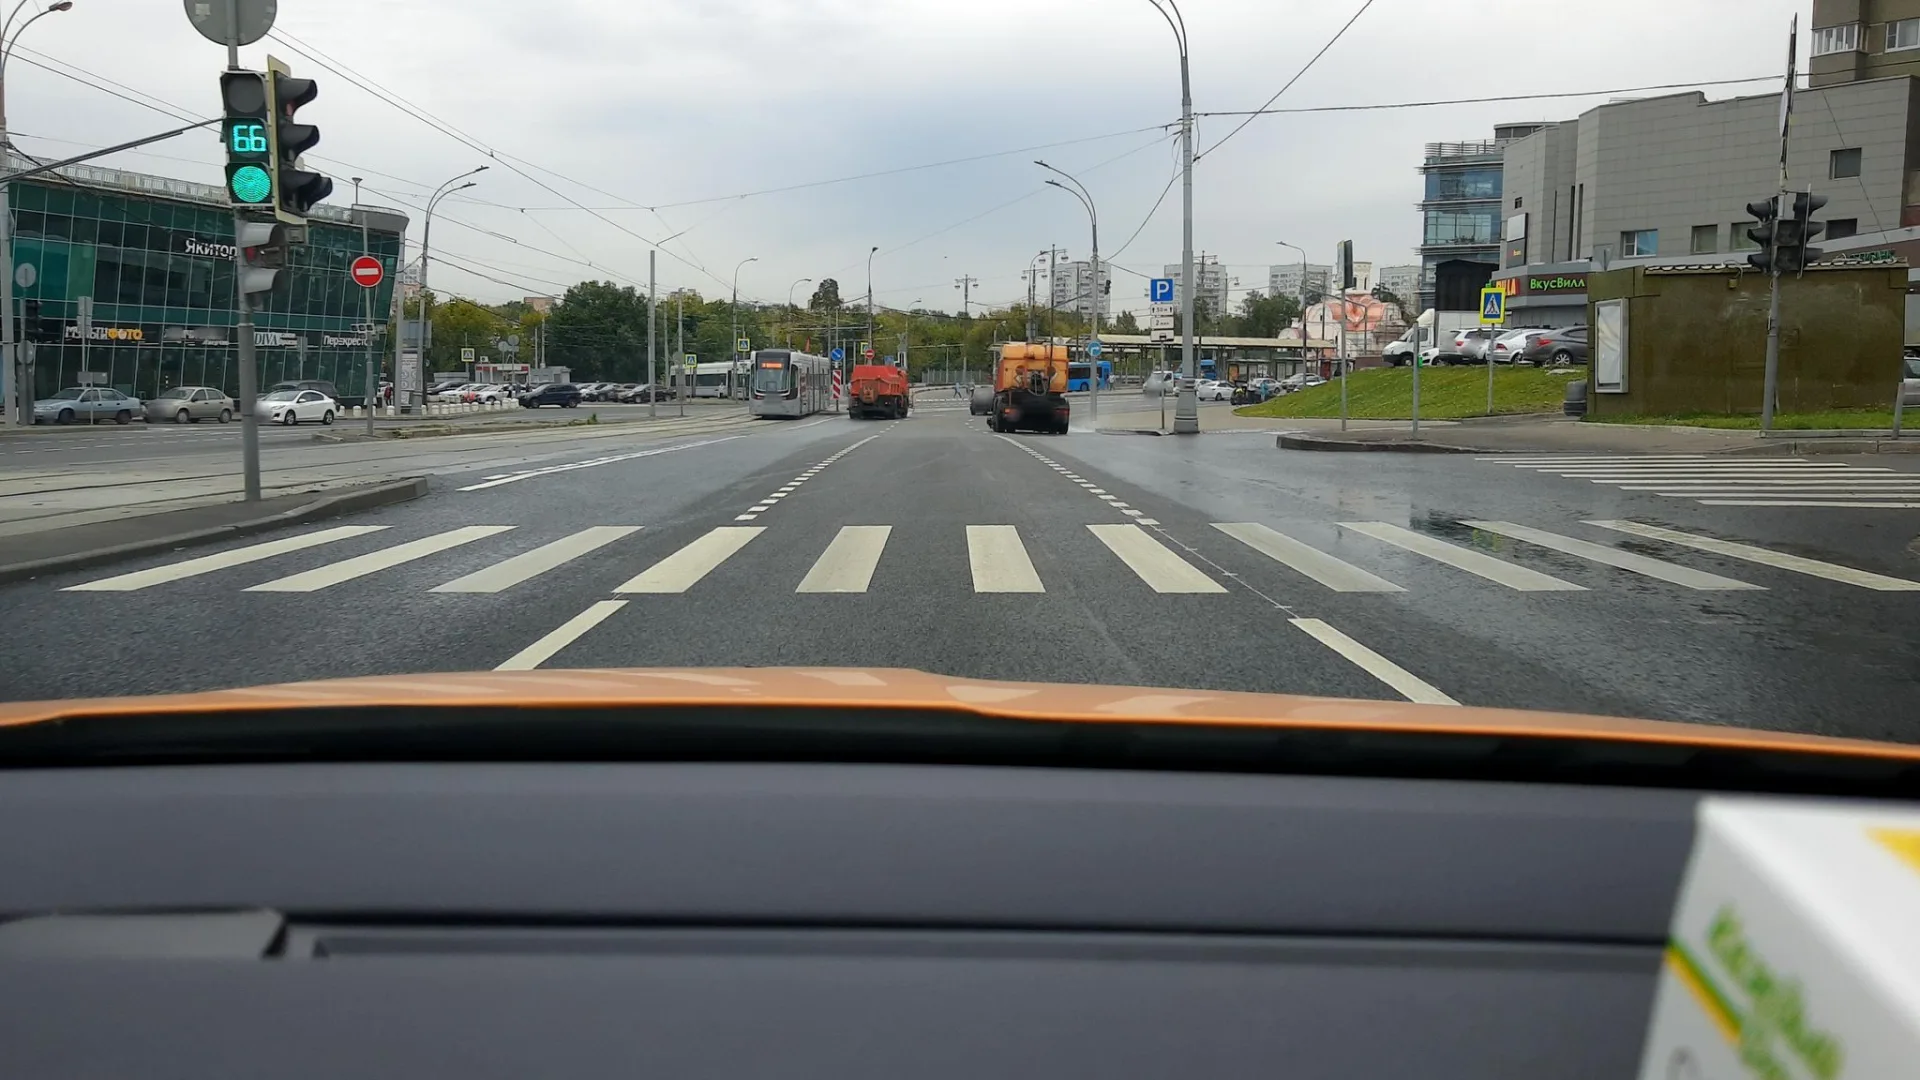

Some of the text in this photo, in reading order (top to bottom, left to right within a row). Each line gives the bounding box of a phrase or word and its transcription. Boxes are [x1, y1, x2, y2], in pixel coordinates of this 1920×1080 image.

[233, 124, 267, 152] 66
[185, 237, 238, 261] Якитор
[1156, 280, 1170, 299] P
[1530, 277, 1586, 291] ВкусВилл
[65, 325, 143, 341] МУЬТИФОТО
[254, 332, 278, 346] DIVA
